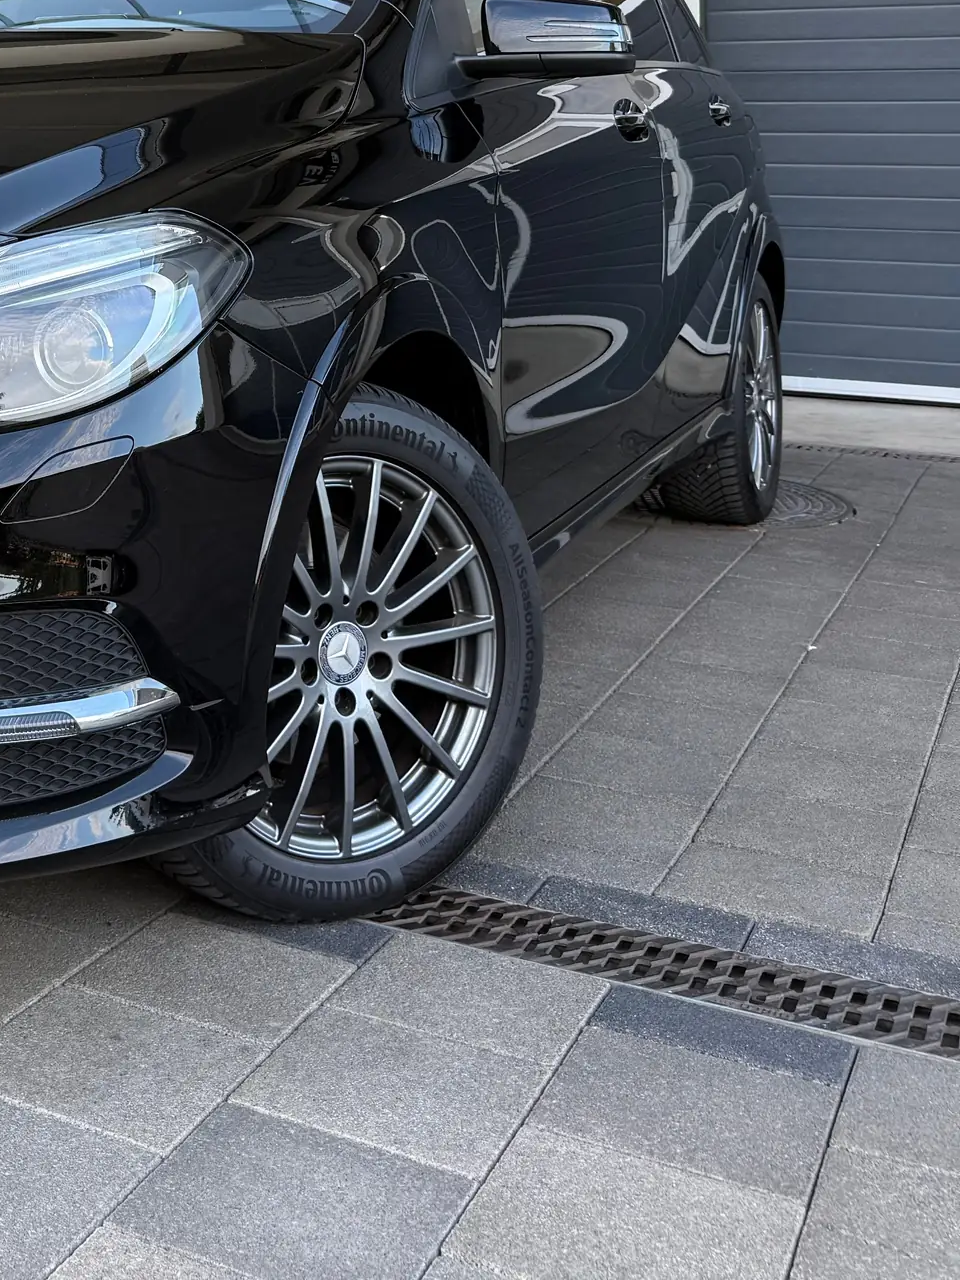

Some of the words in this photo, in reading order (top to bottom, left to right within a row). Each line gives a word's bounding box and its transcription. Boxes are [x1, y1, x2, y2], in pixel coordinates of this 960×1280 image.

[331, 412, 446, 463] ontinental
[509, 543, 536, 712] AllSeasonContact
[246, 862, 390, 901] Continental
